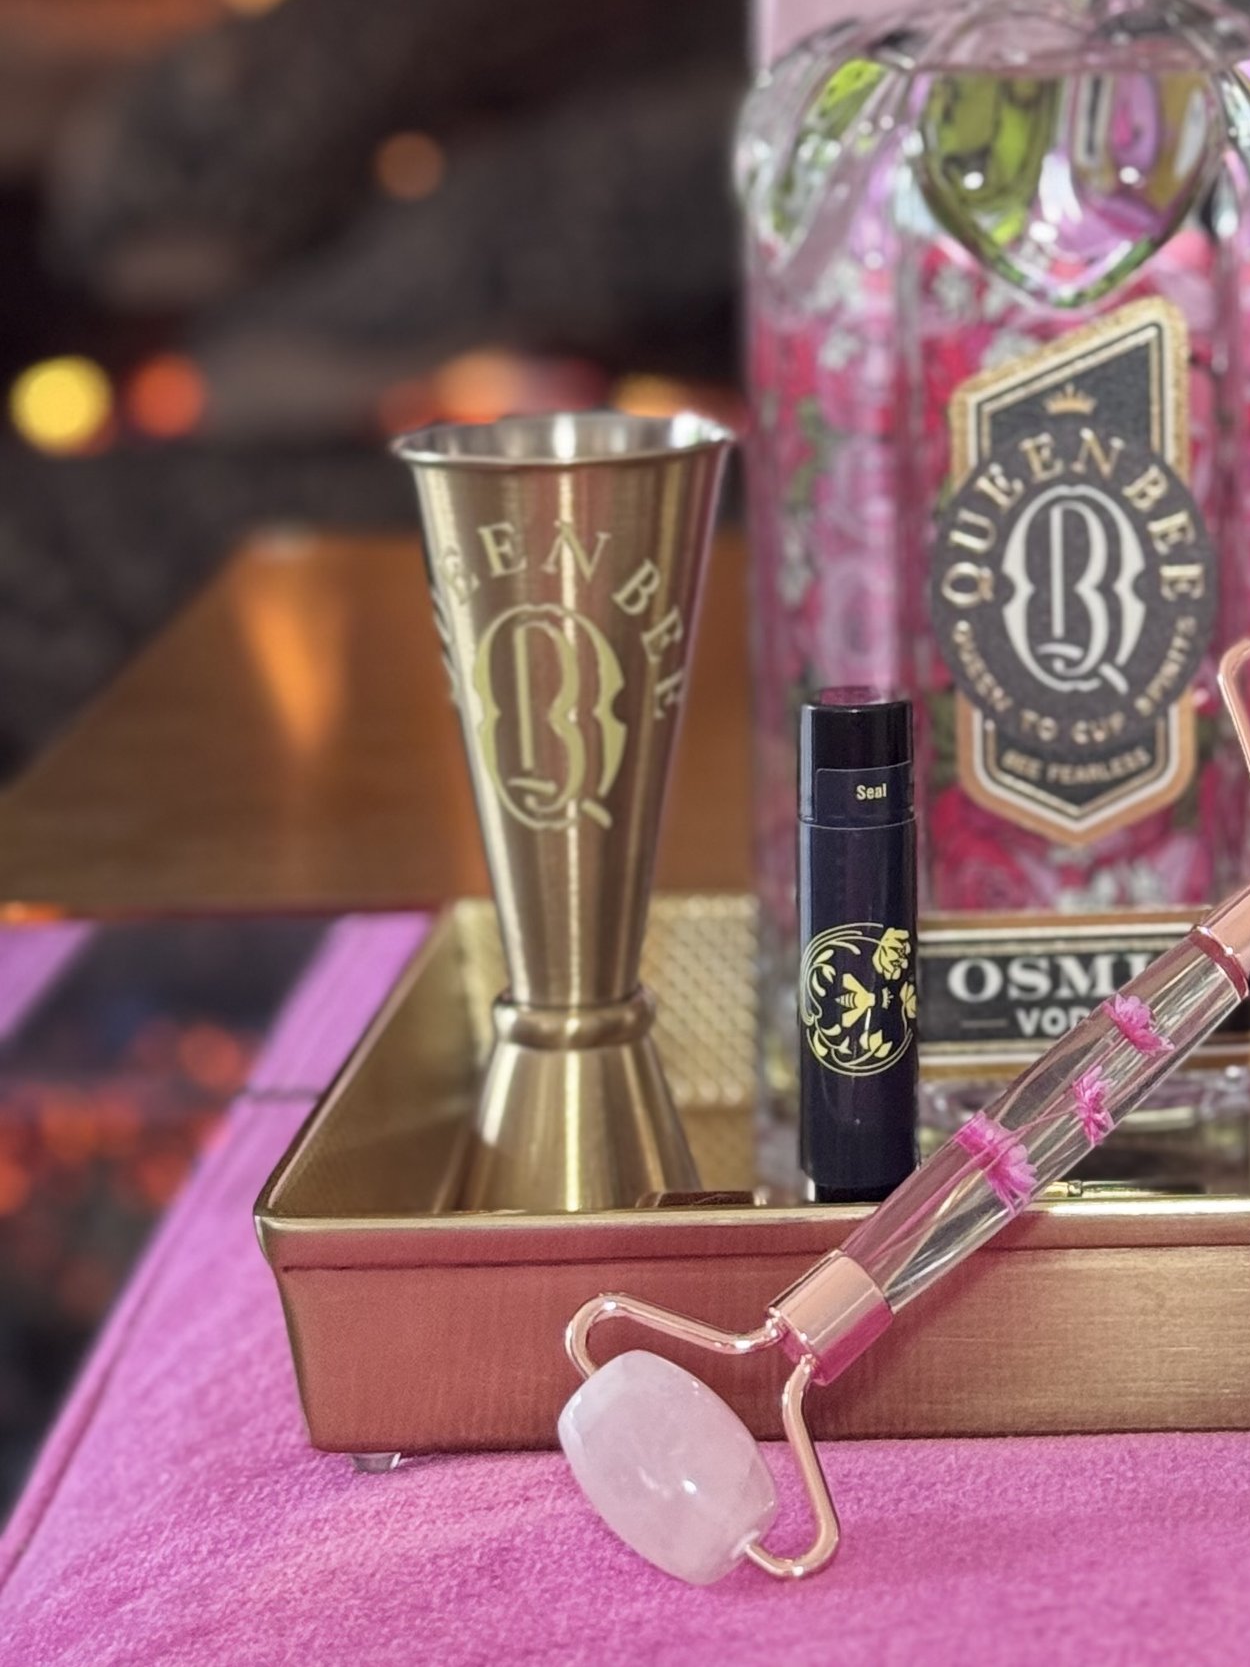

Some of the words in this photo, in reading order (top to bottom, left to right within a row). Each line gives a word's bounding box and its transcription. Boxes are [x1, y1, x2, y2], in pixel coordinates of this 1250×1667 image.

[1020, 708, 1058, 742] TO
[1071, 710, 1125, 745] CUP
[856, 783, 887, 801] Seal
